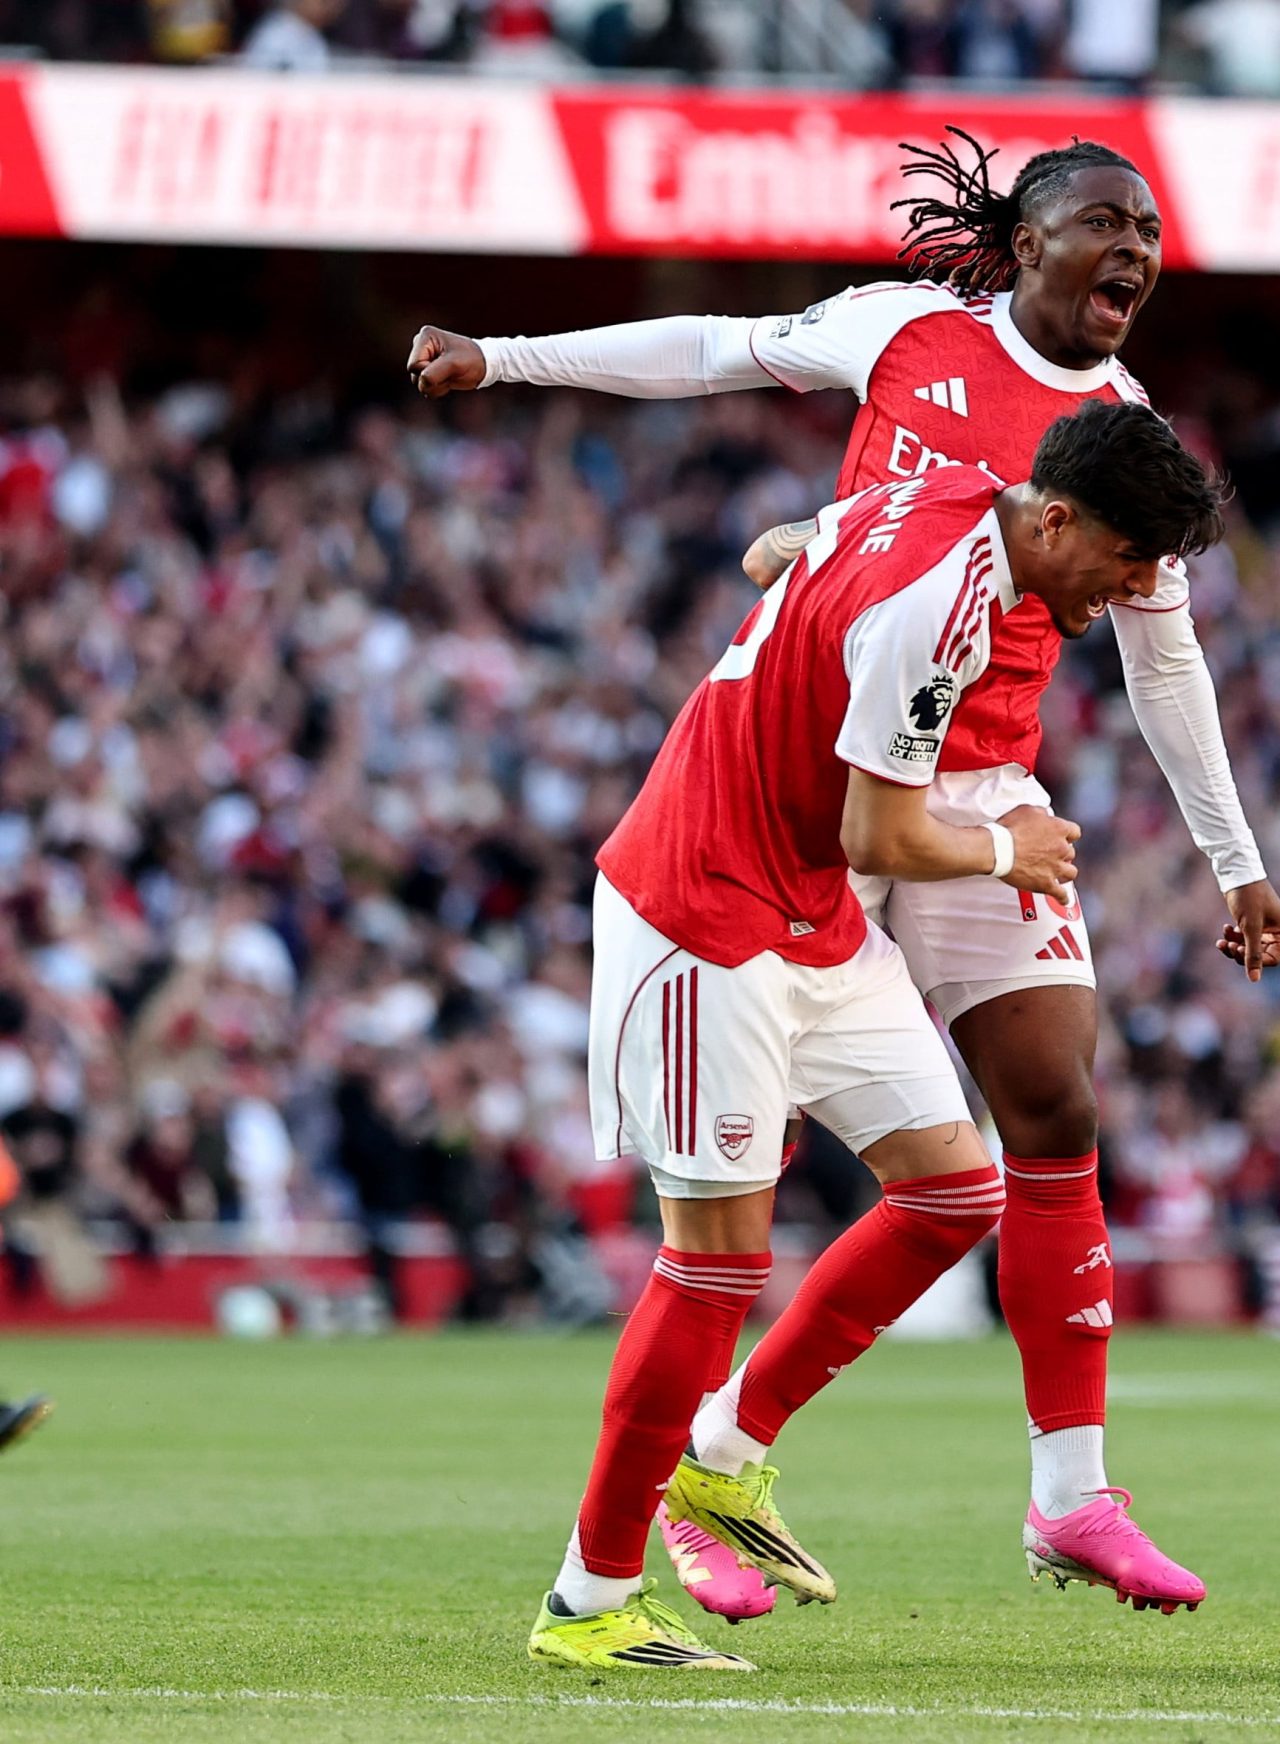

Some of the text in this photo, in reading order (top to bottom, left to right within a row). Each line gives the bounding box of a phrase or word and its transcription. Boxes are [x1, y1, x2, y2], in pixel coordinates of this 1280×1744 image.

[891, 733, 935, 751] No room
[888, 743, 908, 758] for
